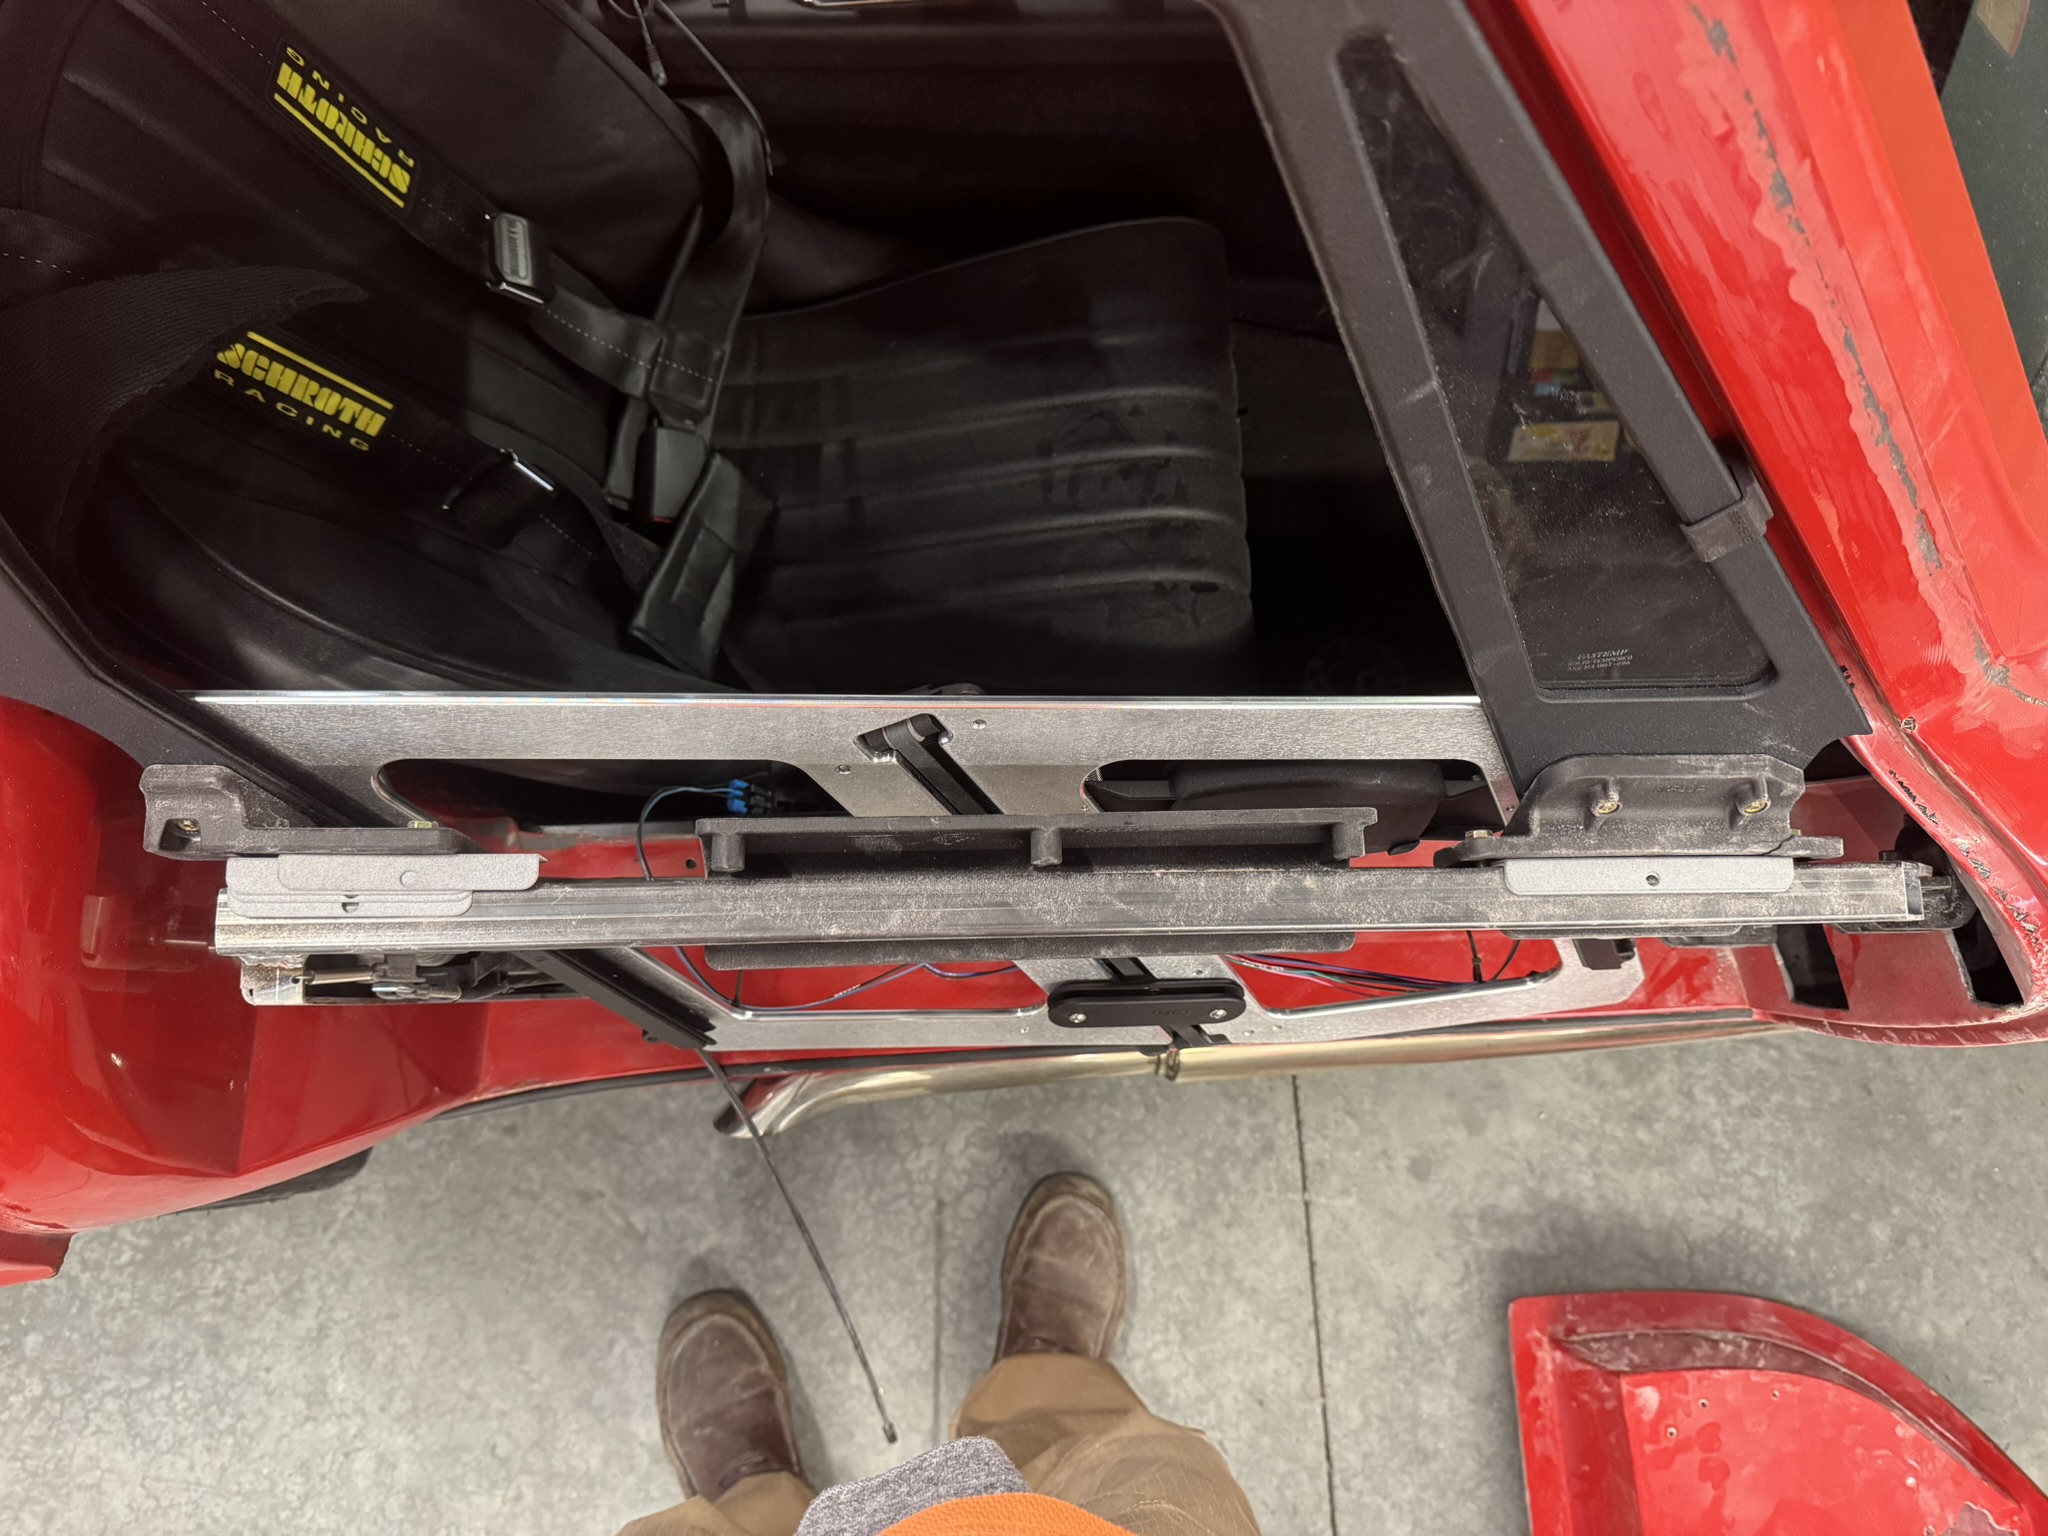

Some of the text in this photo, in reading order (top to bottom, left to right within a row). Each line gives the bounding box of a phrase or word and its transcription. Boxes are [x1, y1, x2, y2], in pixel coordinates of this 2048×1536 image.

[277, 62, 411, 194] SCHROTH
[286, 46, 416, 168] RACING
[213, 368, 370, 452] RACING
[216, 342, 388, 438] SCHROTH
